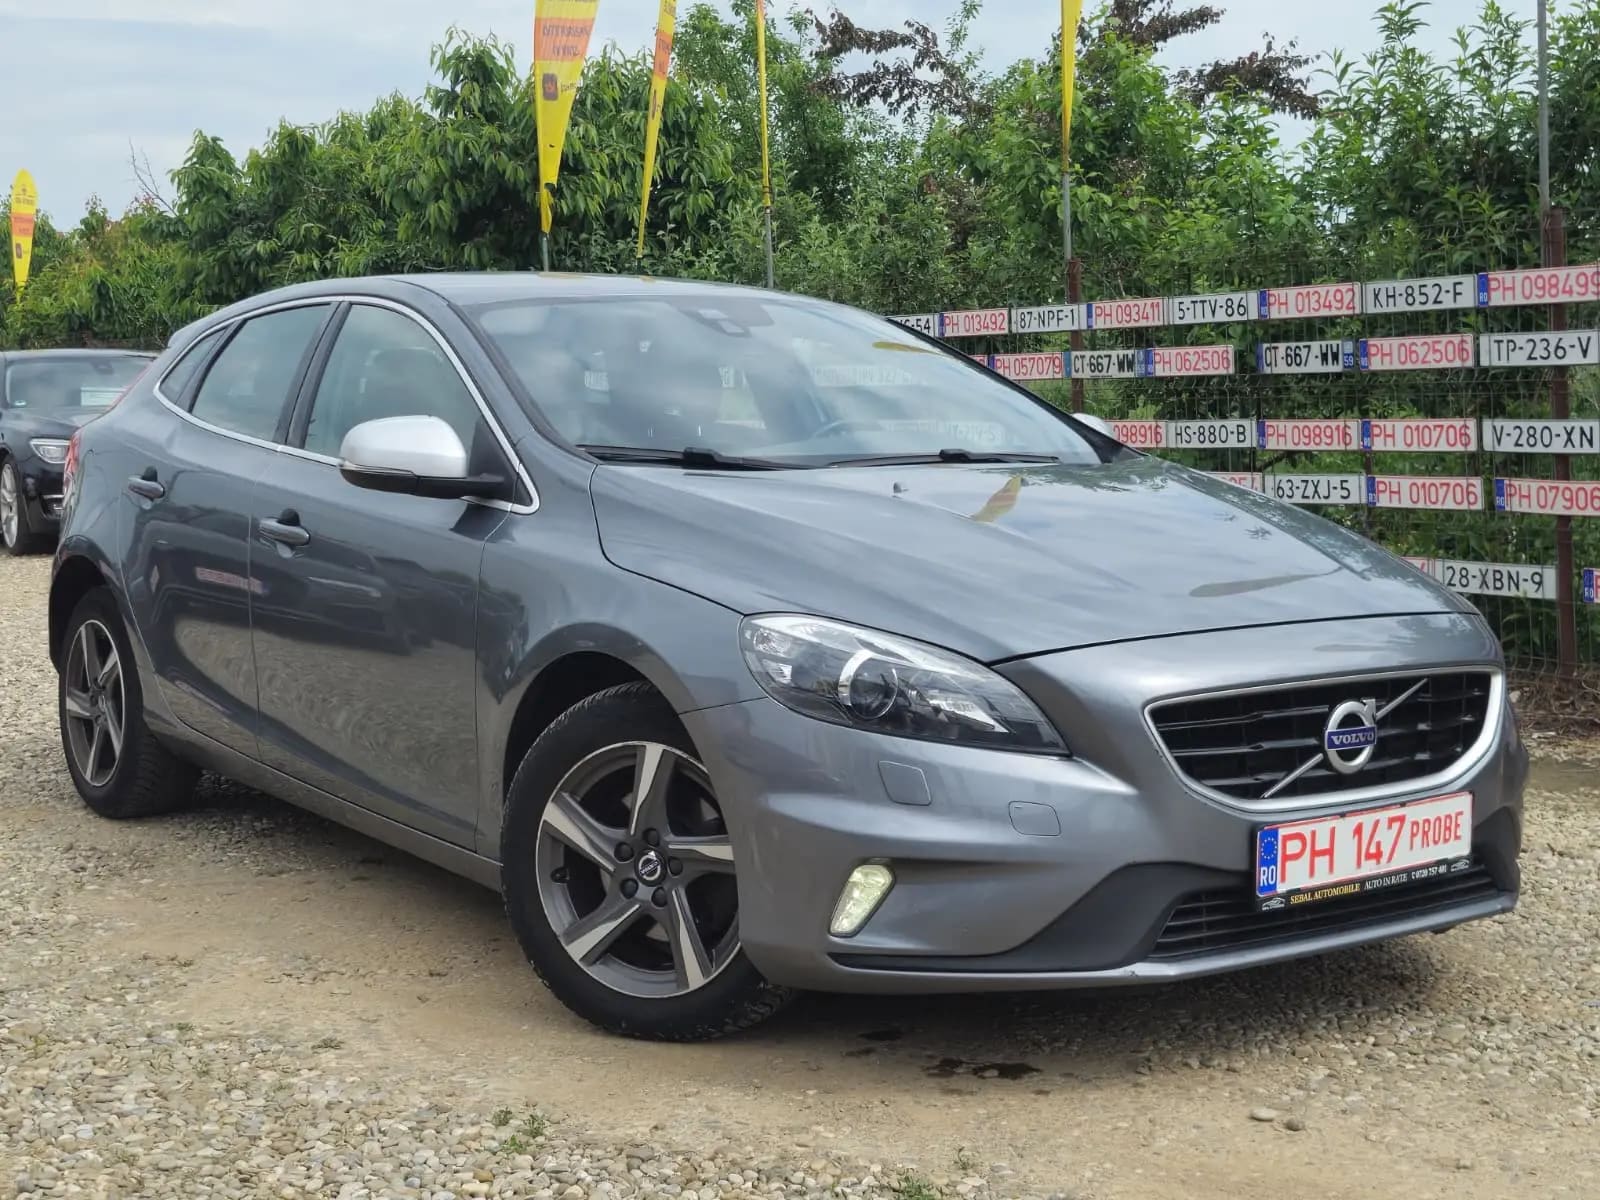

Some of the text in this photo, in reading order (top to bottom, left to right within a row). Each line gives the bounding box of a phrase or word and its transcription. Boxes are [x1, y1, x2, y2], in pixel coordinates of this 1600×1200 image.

[1373, 281, 1464, 309] KH-852-F
[1488, 275, 1516, 302] PH
[1094, 301, 1160, 326] PH 093411
[1178, 296, 1247, 320] 5-TTV-86
[1268, 288, 1356, 315] PH 013492
[943, 312, 1006, 334] PH 013492
[1019, 309, 1075, 329] 87-NPF-1
[1154, 351, 1172, 373] PH
[1175, 349, 1231, 372] 062506
[1343, 355, 1354, 367] 59
[1368, 339, 1470, 366] PH 062506
[1493, 336, 1592, 363] TP-236-V
[995, 355, 1063, 378] PH 057079
[1175, 424, 1247, 444] HS-880-B
[1266, 424, 1287, 446] PH
[1291, 424, 1353, 446] 098916
[1371, 423, 1472, 447] PH 010706
[1493, 425, 1594, 448] V-280-XN
[1276, 478, 1351, 500] 63-ZXJ-5
[1376, 480, 1401, 504] PH
[1409, 482, 1478, 506] 010706
[1505, 483, 1531, 509] PH
[1446, 565, 1543, 593] 28-XBN-9
[1331, 731, 1374, 745] VOLVO
[1281, 810, 1464, 884] PH 147 PROBE
[1260, 865, 1276, 887] RO
[1290, 892, 1312, 904] SEBAL
[1313, 883, 1360, 900] AUTOMOBILE
[1363, 878, 1382, 890] AUTO
[1391, 873, 1408, 885] RATE
